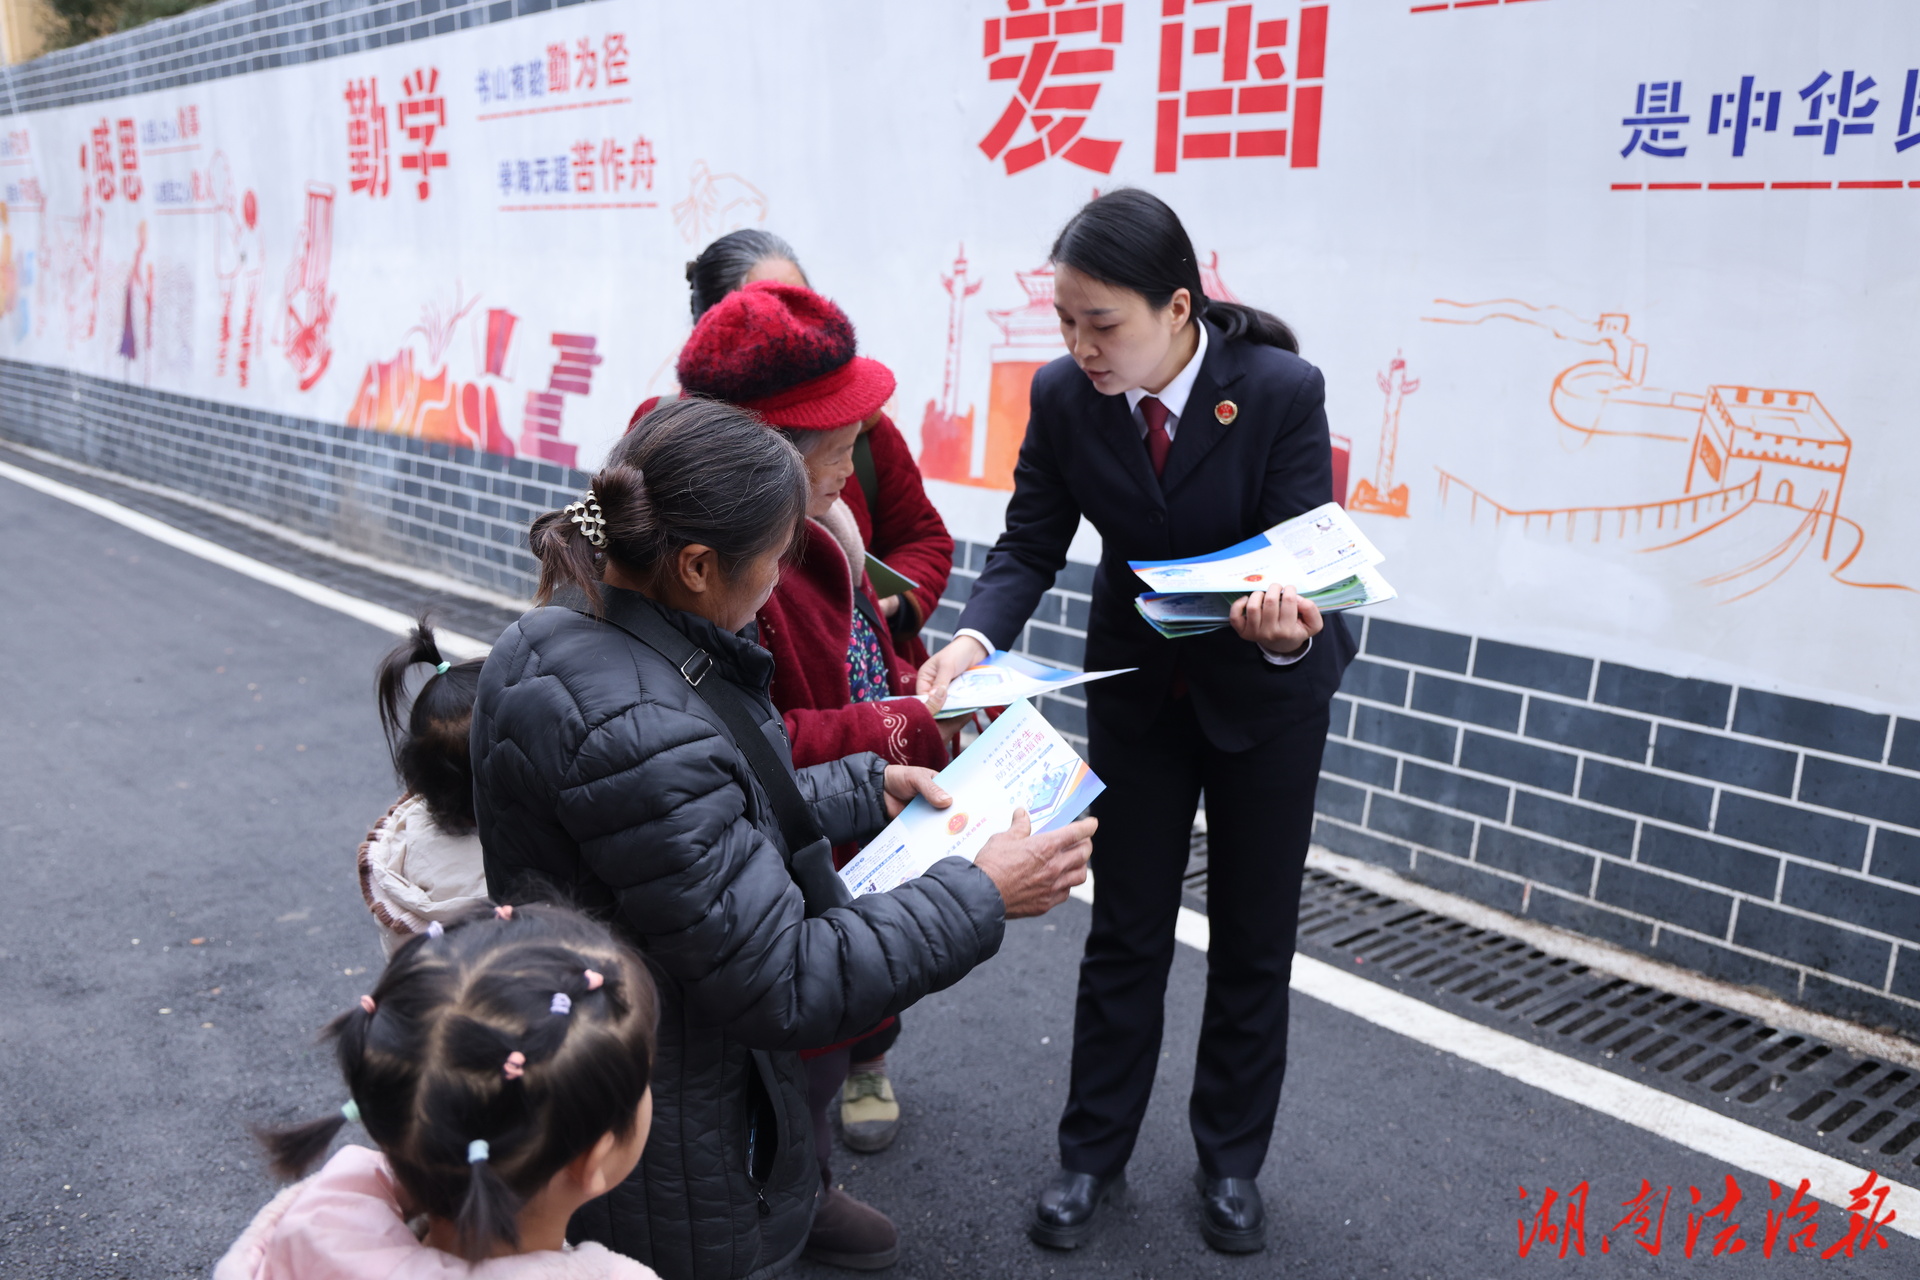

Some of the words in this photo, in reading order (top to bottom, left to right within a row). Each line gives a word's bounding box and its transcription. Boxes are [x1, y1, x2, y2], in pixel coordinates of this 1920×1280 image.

[978, 0, 1328, 176] 爱国
[90, 116, 143, 202] 感恩
[343, 68, 449, 200] 勤学
[994, 729, 1033, 769] 中小学生
[995, 732, 1045, 781] 防诈骗指南
